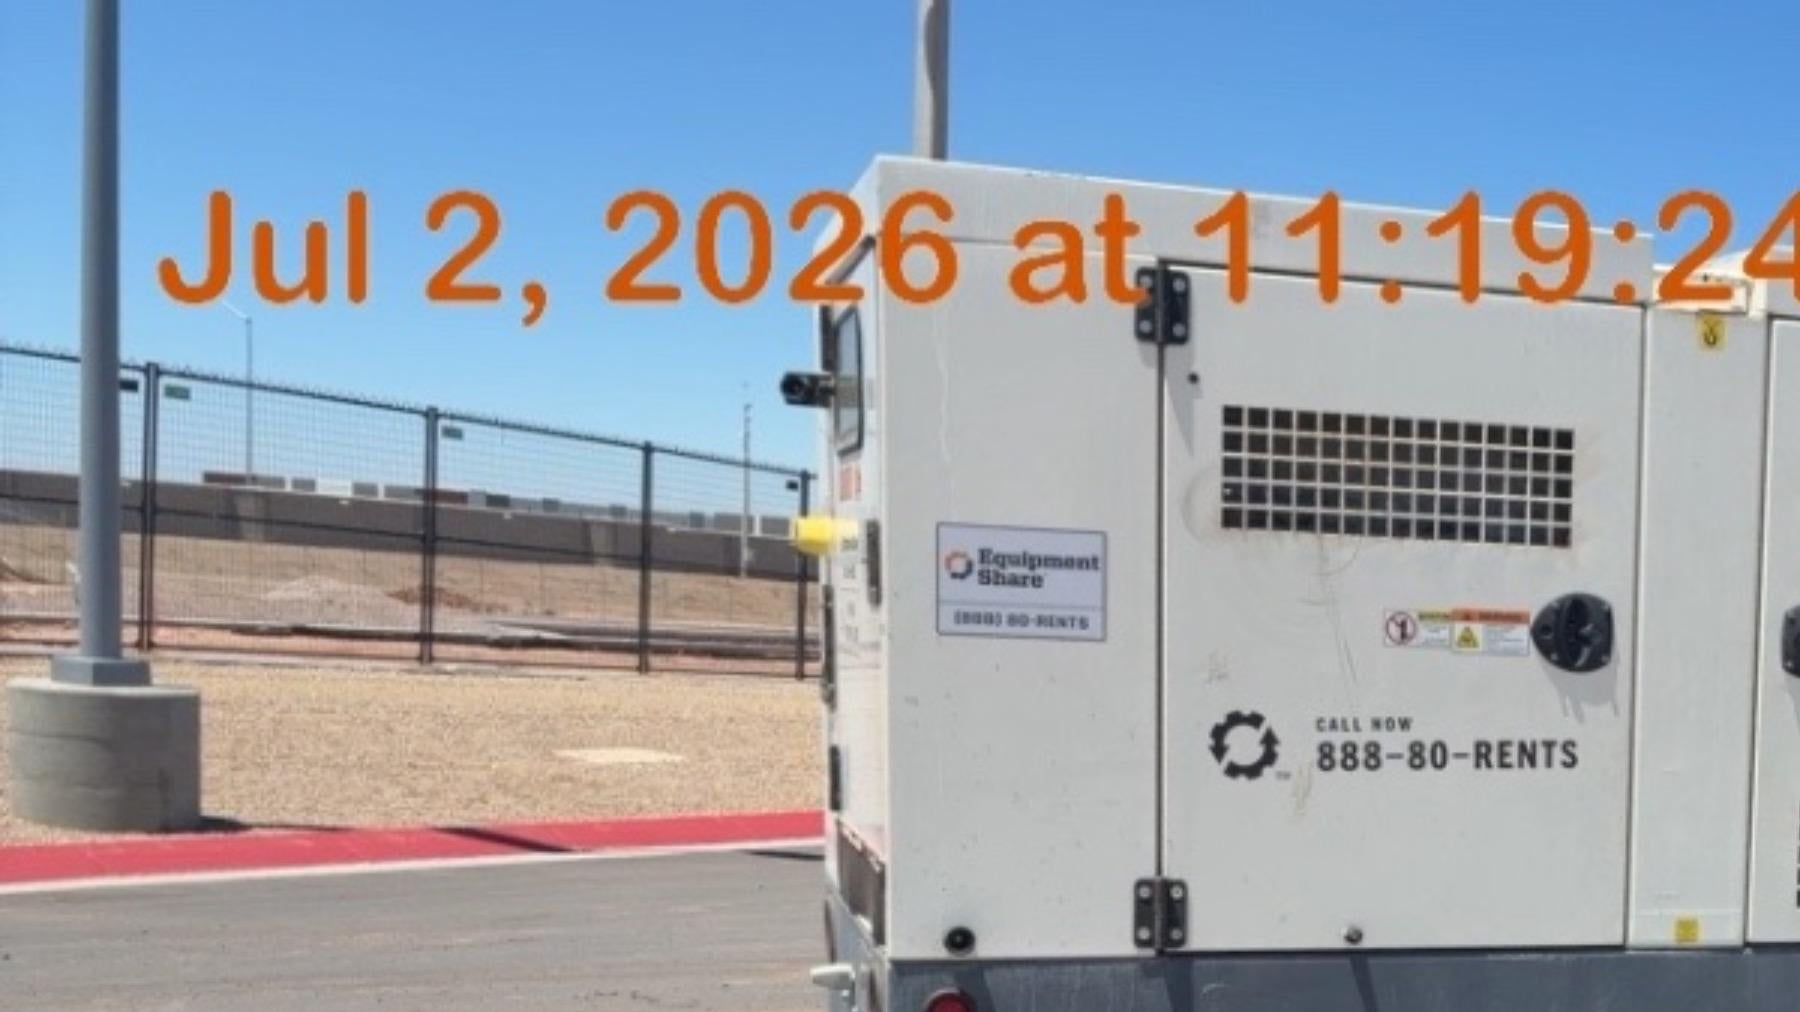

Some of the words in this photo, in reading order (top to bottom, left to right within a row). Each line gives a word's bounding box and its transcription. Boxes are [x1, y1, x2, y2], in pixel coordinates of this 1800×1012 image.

[977, 548, 1100, 571] Equipment
[977, 568, 1044, 588] Share
[1315, 717, 1363, 732] CALL
[1371, 717, 1413, 732] NOW
[1317, 739, 1580, 772] 888-80-RENTS
